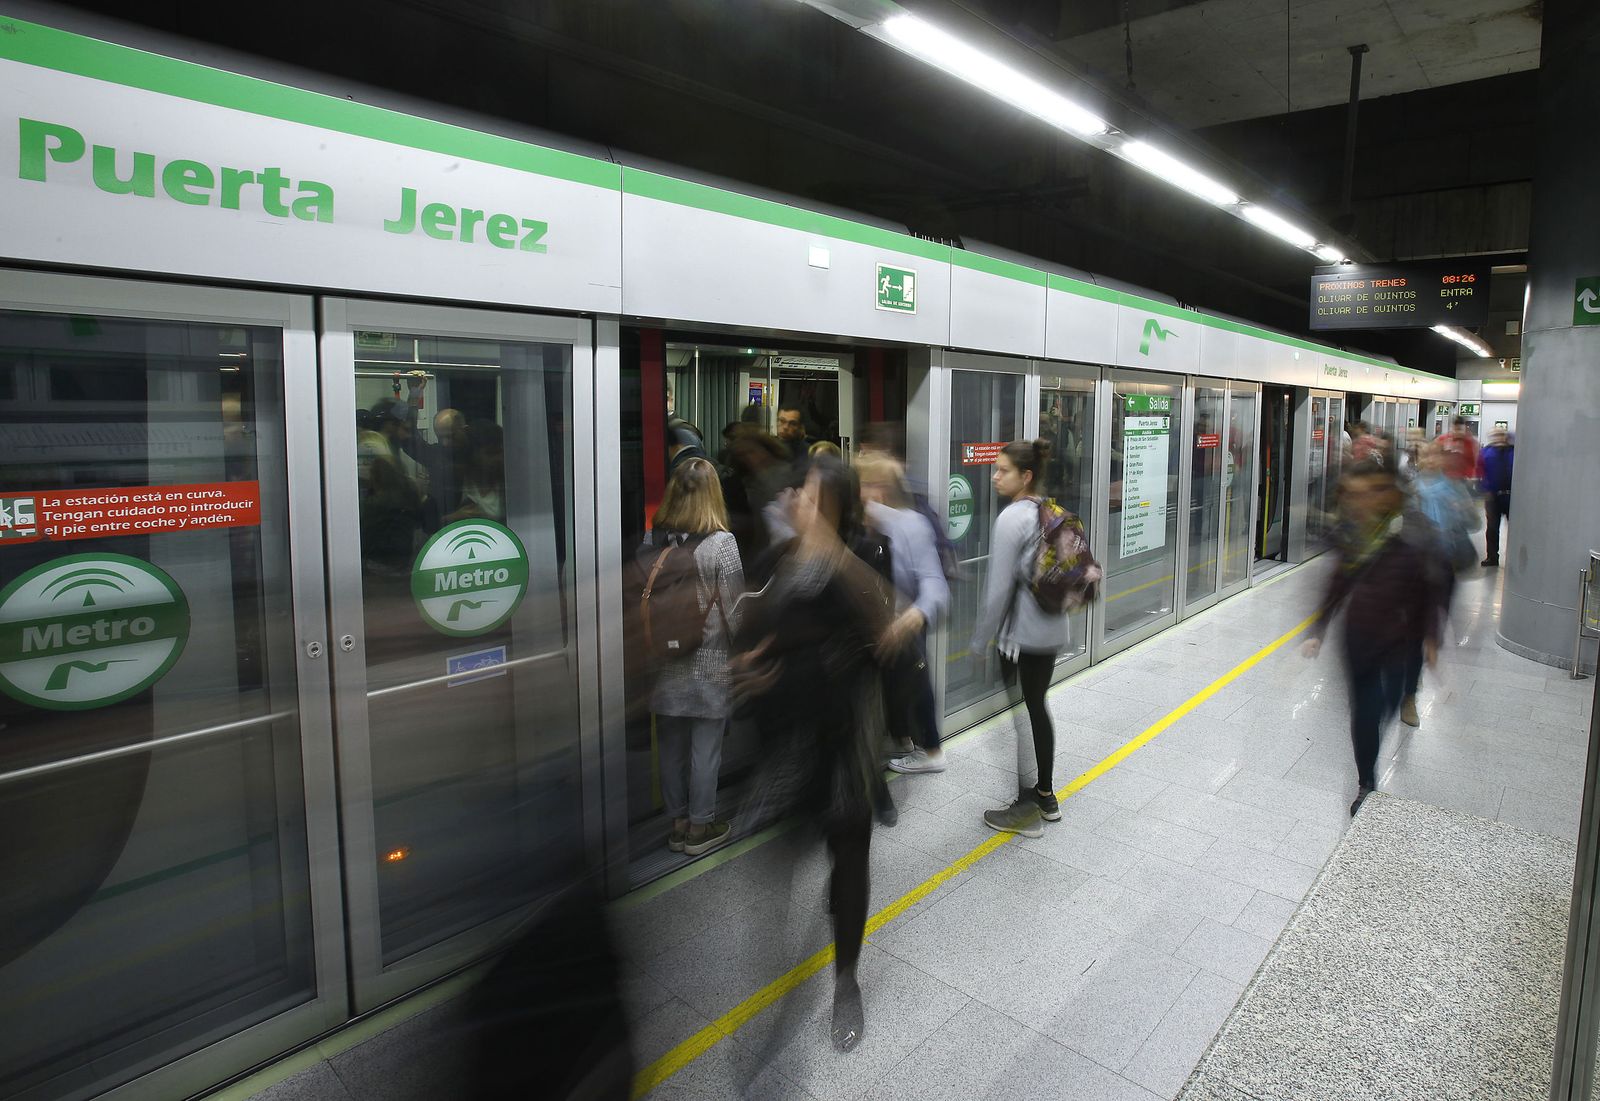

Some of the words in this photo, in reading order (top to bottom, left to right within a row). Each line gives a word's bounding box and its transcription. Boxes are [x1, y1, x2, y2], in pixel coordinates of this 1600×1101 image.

[18, 117, 334, 224] Puerta
[383, 187, 549, 254] Jerez
[1320, 281, 1364, 291] PROXIMOS
[1370, 279, 1406, 288] TRENES
[1442, 275, 1475, 284] 08:26
[1318, 294, 1352, 303] OLIVAR
[1357, 293, 1368, 301] DE
[1374, 291, 1416, 300] QUINTOS
[1440, 288, 1473, 297] ENTRA
[1318, 306, 1352, 315] OLIVAR
[1356, 305, 1368, 314] DE
[1374, 304, 1416, 313] QUINTOS
[1150, 397, 1169, 410] Salida
[42, 497, 60, 507] La
[65, 494, 129, 506] estación
[132, 492, 162, 503] está
[165, 492, 183, 501] en
[186, 490, 226, 500] curva.
[42, 509, 103, 522] Tengan
[107, 505, 165, 517] cuidado
[169, 505, 187, 513] no
[191, 500, 254, 512] introducir
[950, 503, 967, 514] etro
[44, 525, 58, 535] el
[62, 523, 86, 537] pie
[90, 521, 131, 532] entre
[134, 518, 176, 529] coche
[178, 518, 188, 528] y
[190, 513, 236, 525] andén.
[434, 567, 509, 593] Metro
[22, 615, 156, 653] Metro
